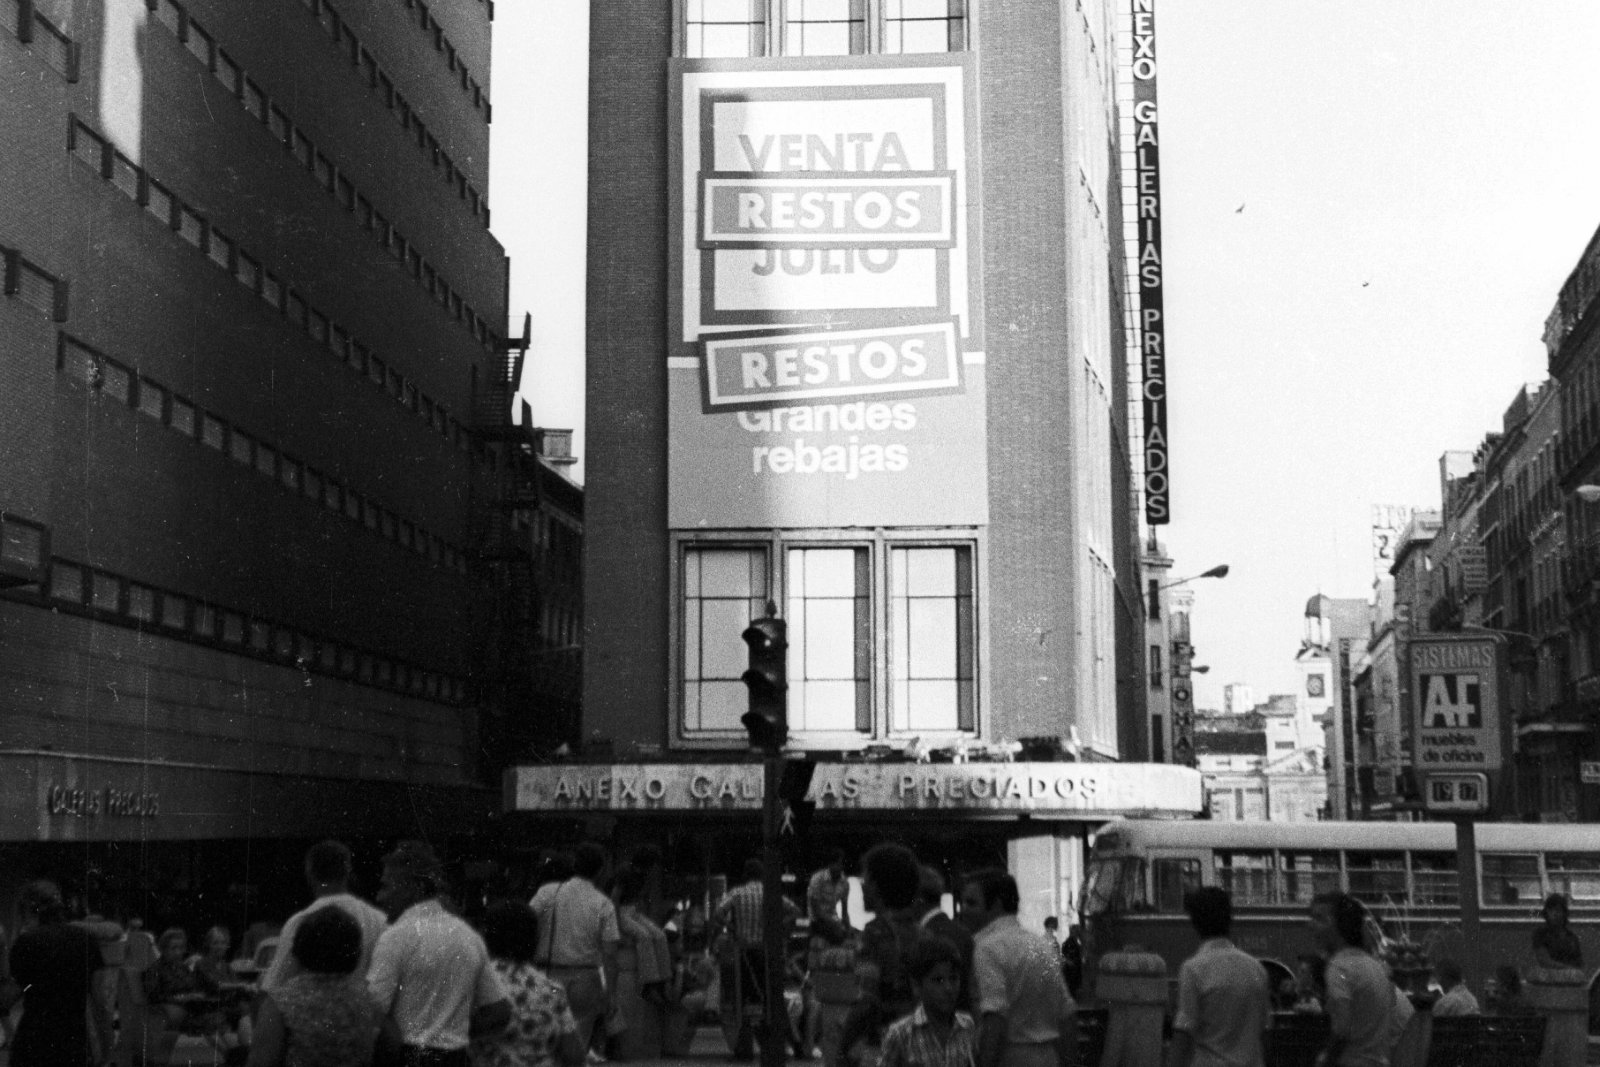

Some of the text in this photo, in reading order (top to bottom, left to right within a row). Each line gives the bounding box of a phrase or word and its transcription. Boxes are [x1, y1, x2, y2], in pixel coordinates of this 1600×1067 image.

[738, 131, 911, 172] VENTA
[737, 191, 921, 229] RESTOS
[1134, 101, 1161, 287] GALERIAS
[751, 248, 898, 277] JULIO
[741, 338, 927, 389] RESTOS
[737, 401, 916, 433] Grandes
[1143, 308, 1167, 518] PRECIADOS
[752, 436, 909, 480] rebajas
[1412, 645, 1493, 669] SISTEMAS
[1423, 674, 1479, 727] AF
[553, 773, 1098, 801] ANEXO GALAS PRECIADOS
